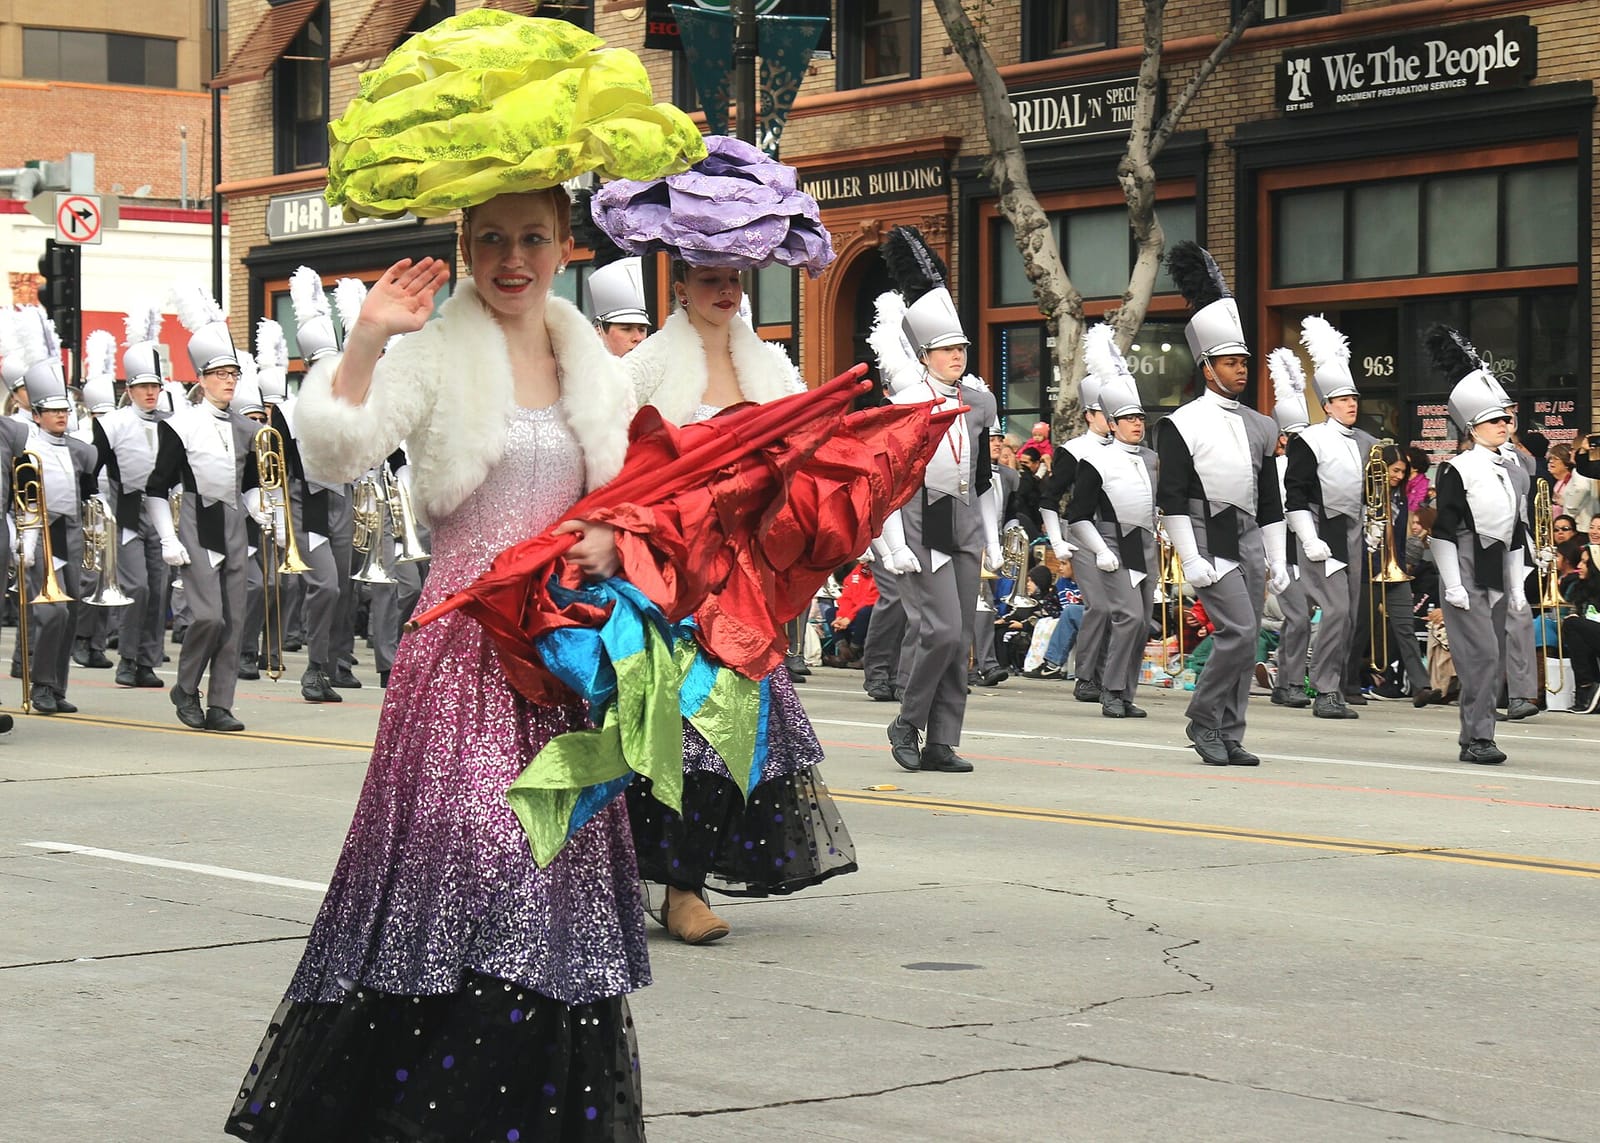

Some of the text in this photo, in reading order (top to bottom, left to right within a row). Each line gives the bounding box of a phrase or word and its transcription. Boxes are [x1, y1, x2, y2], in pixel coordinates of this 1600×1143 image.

[649, 22, 681, 35] HO
[1322, 29, 1520, 91] We The People
[1106, 86, 1137, 105] SPECI
[1336, 78, 1467, 103] DOCUMENT PREPARATION SERVICES
[1111, 106, 1137, 123] TIME
[1286, 103, 1298, 112] EST
[803, 166, 942, 201] MULLER BUILDING
[283, 198, 323, 233] H&R
[1127, 355, 1166, 375] 961
[1363, 355, 1394, 377] 963
[1417, 404, 1449, 416] DIVORC
[1534, 401, 1552, 413] INC
[1558, 400, 1575, 413] LLC
